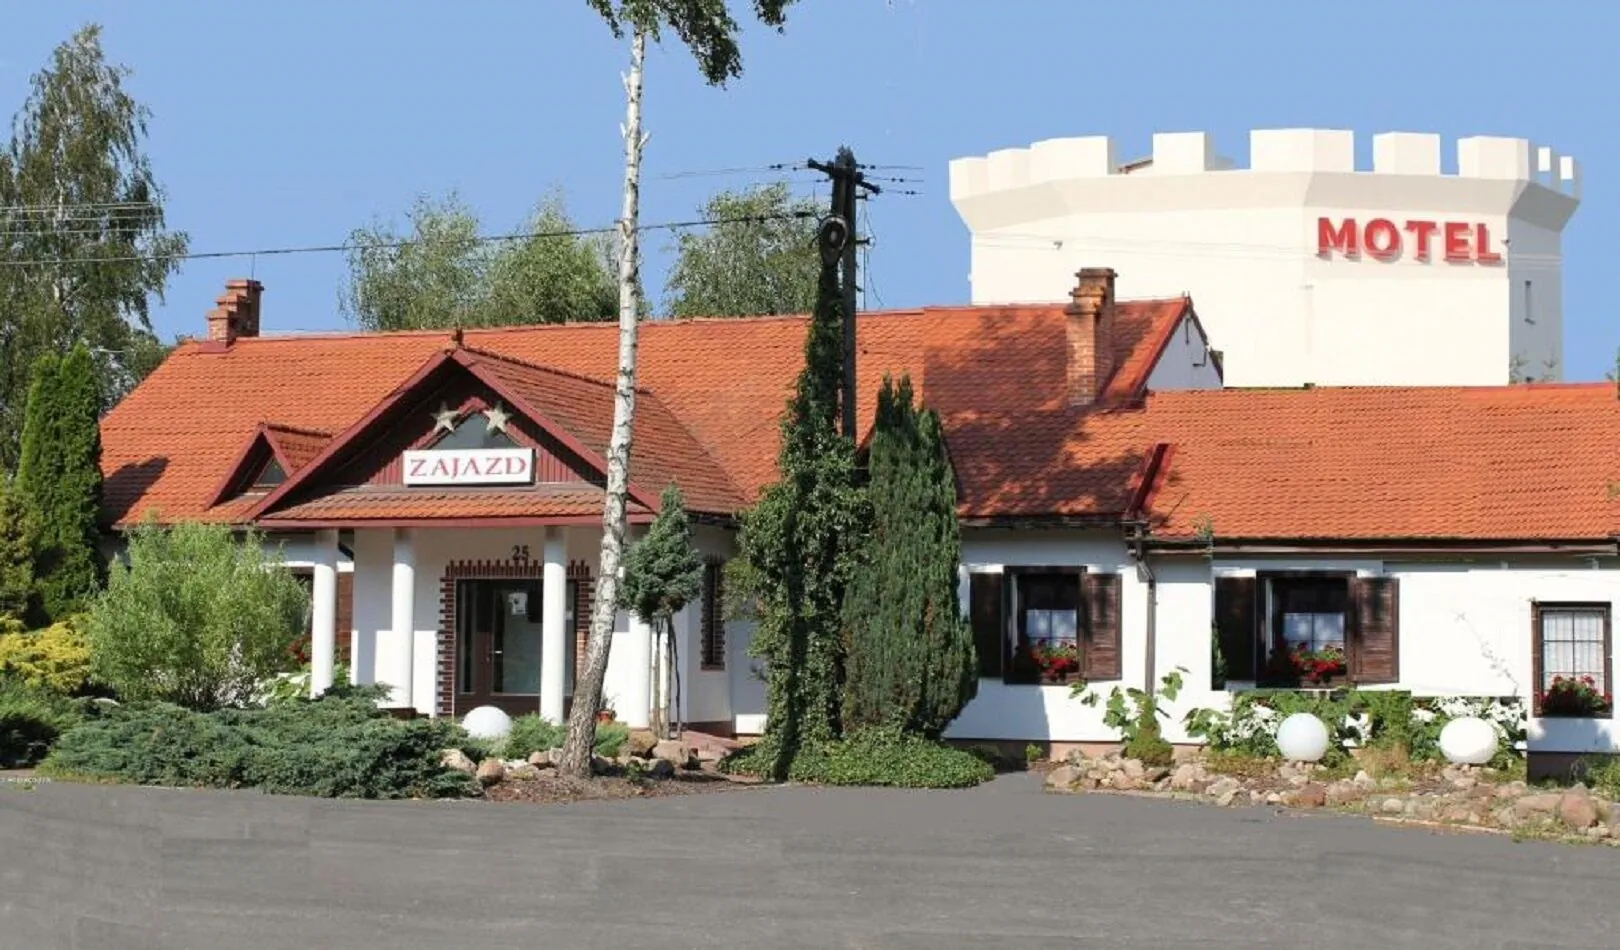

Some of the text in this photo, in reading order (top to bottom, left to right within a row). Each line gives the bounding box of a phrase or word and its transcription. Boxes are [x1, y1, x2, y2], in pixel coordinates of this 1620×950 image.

[1317, 217, 1502, 264] MOTEL
[409, 457, 527, 479] ZAJAZD
[511, 544, 529, 560] 25
